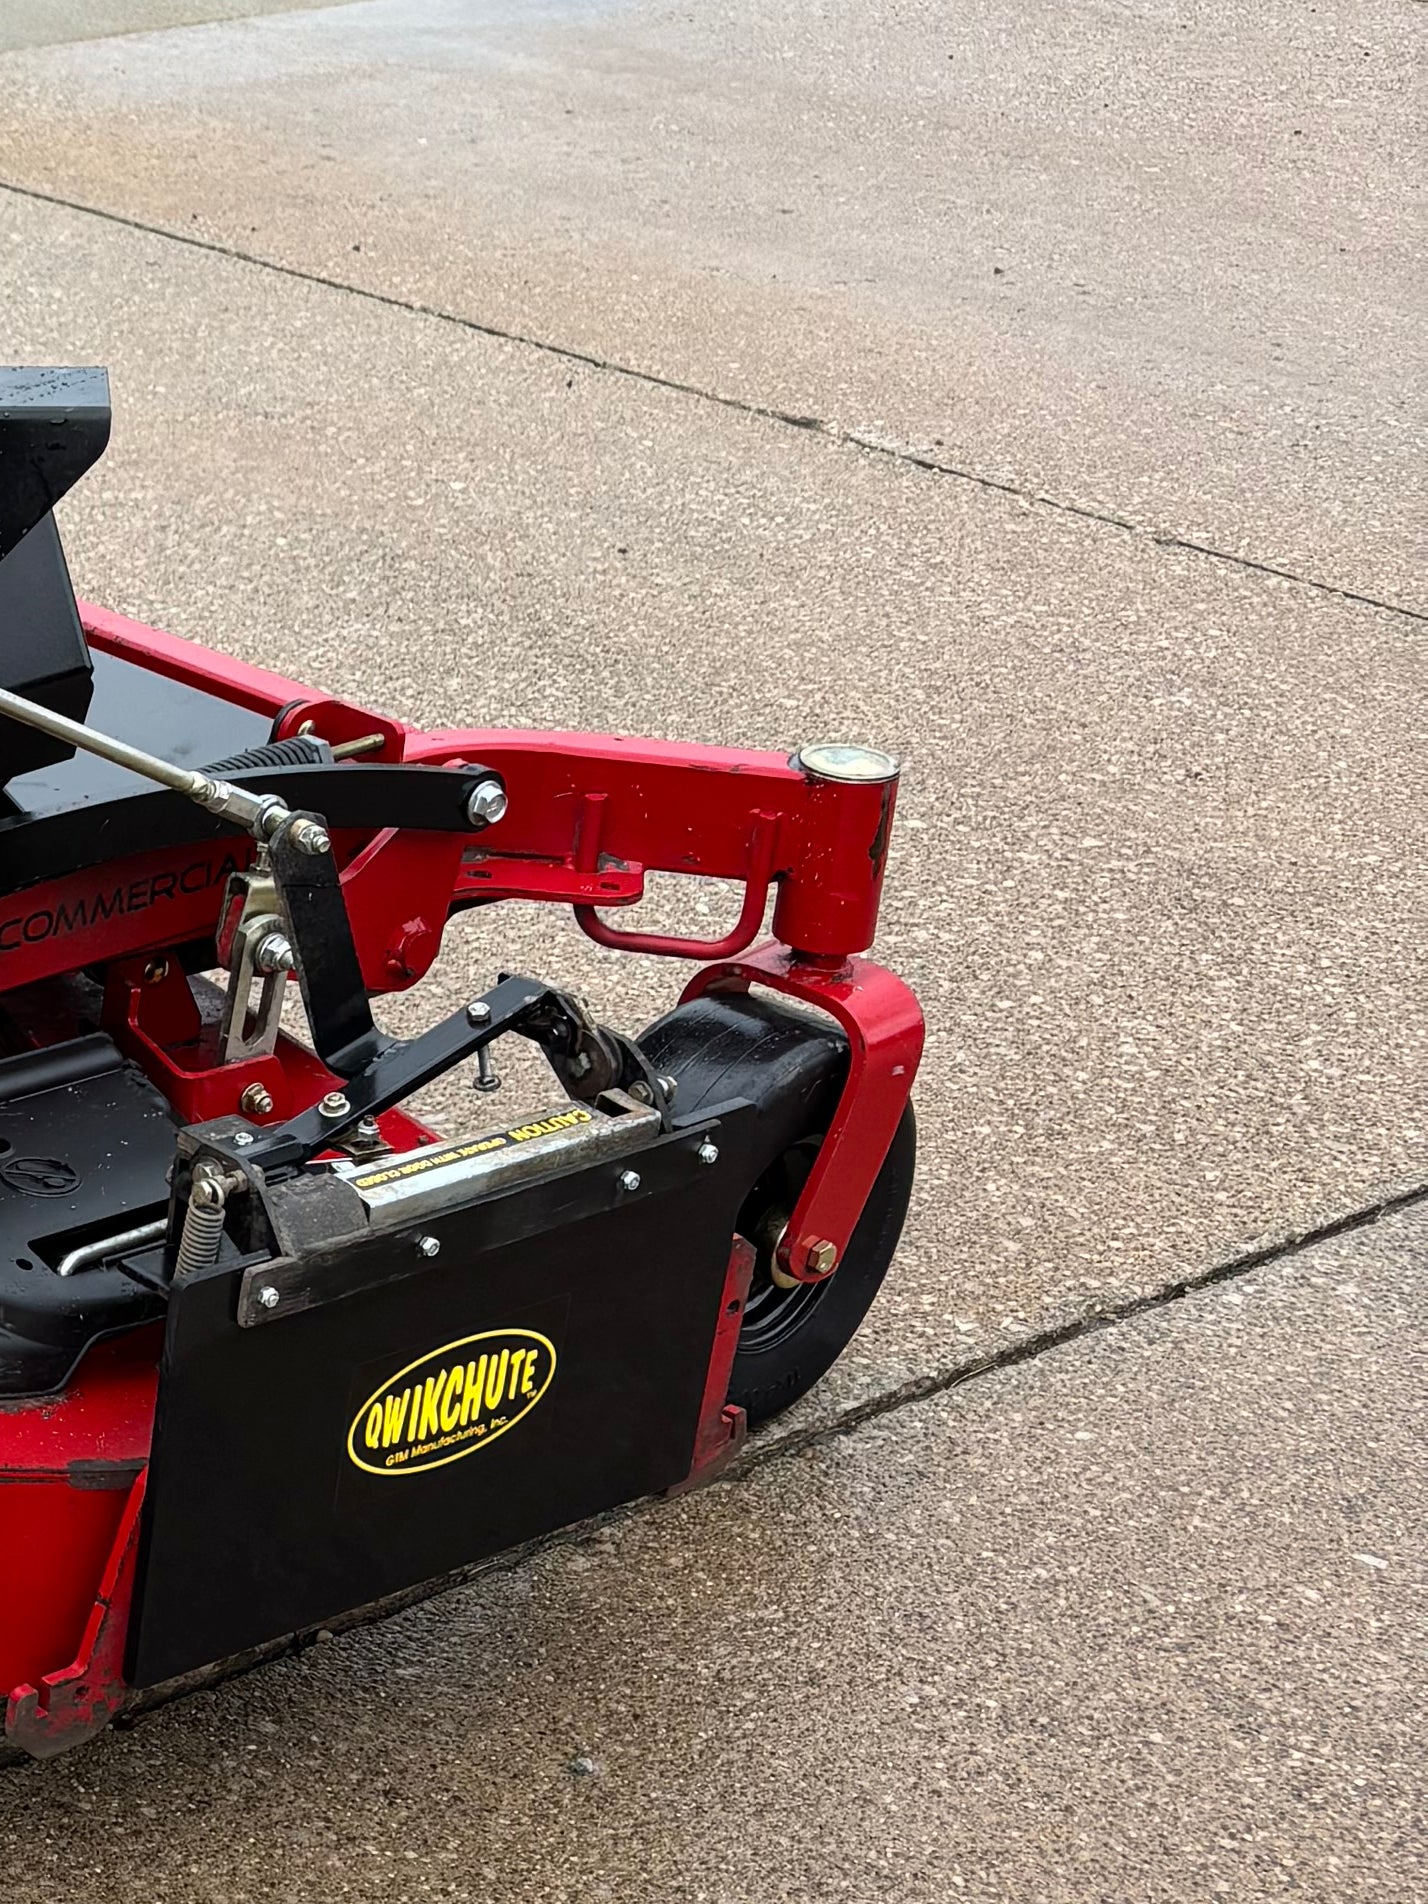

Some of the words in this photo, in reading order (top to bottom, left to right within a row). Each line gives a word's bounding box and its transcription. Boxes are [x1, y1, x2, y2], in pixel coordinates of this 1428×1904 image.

[508, 1108, 593, 1142] CAUTION
[365, 1348, 539, 1450] QWIKCHUTE
[490, 1416, 509, 1429] Inc.
